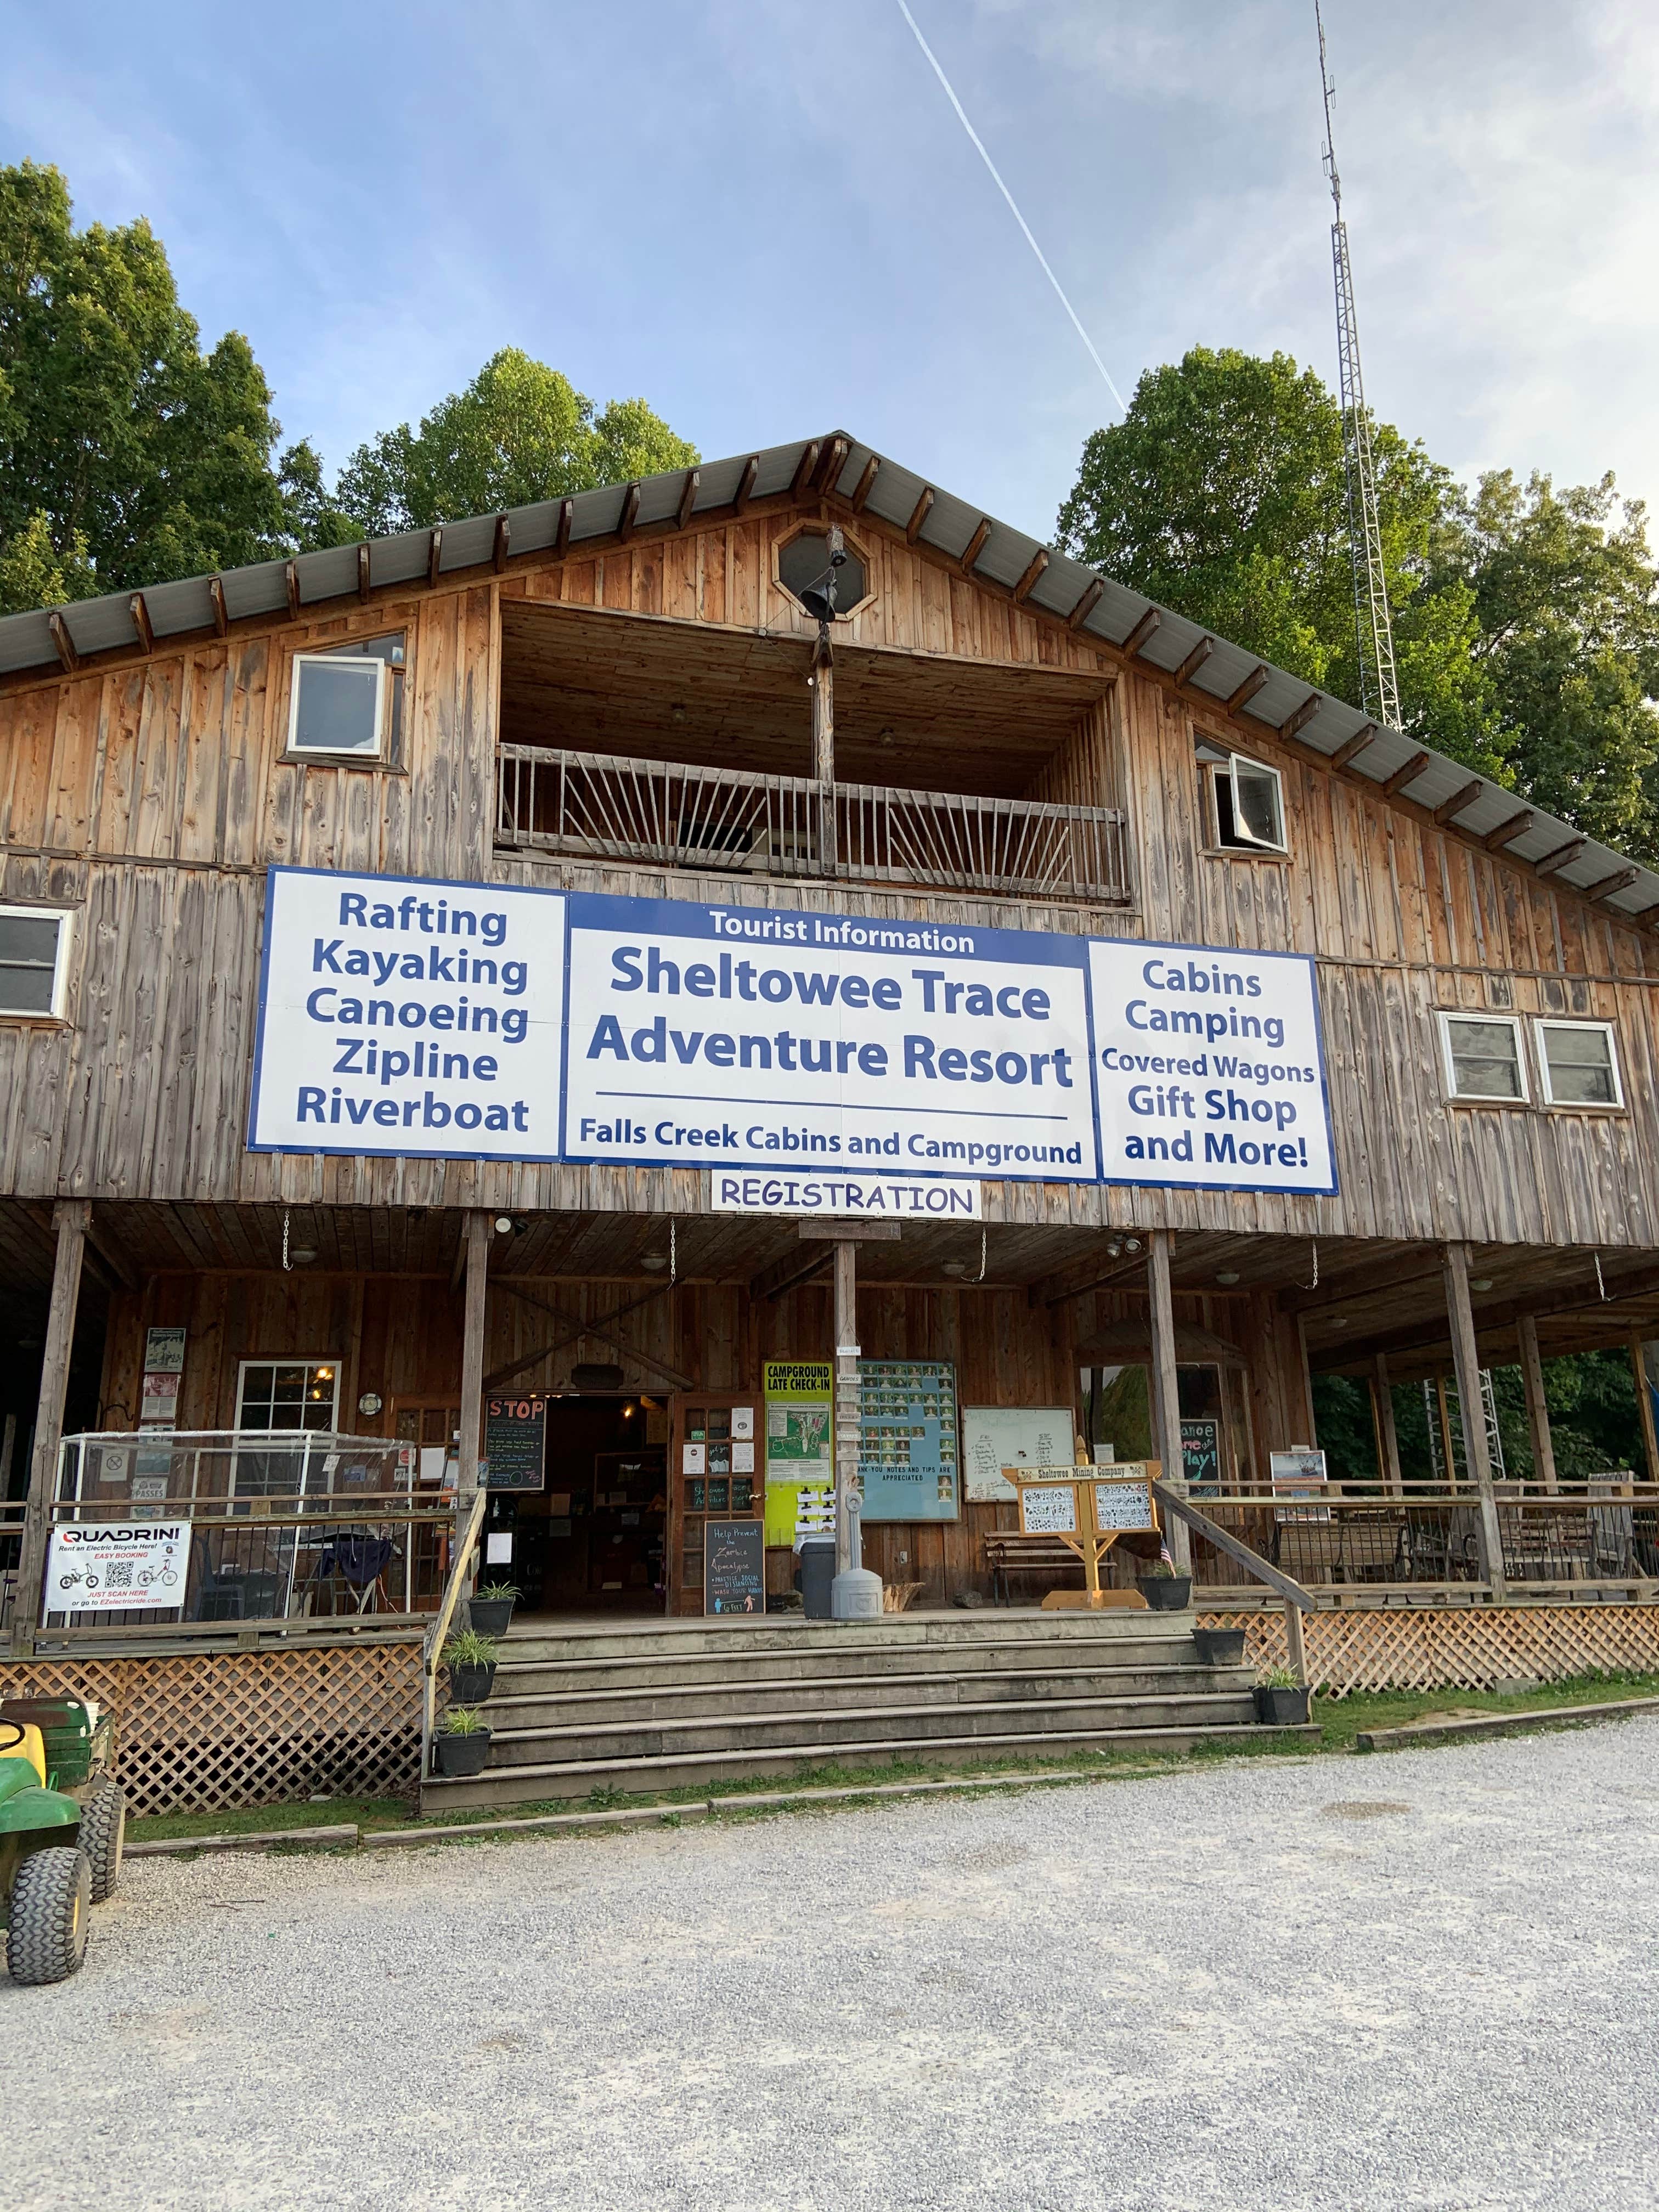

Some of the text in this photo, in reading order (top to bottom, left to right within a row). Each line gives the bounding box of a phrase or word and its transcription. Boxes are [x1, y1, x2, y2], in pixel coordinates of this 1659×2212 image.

[339, 893, 507, 946] Rafting
[709, 911, 974, 953] Tourist Information
[312, 939, 528, 996] Kayaking
[611, 946, 1050, 1020] Sheltowee Trace
[1143, 960, 1261, 997] Cabins
[306, 988, 528, 1043] Canoeing
[1125, 1000, 1284, 1048] Camping
[333, 1038, 498, 1085] Zipline
[586, 1014, 1073, 1088] Adventure Resort
[1101, 1047, 1315, 1086] Covered Wagons
[296, 1086, 529, 1132] Riverboat
[1128, 1085, 1297, 1131] Gift Shop
[580, 1118, 1082, 1166] Falls Creek Cabins and Campground
[1125, 1130, 1308, 1168] and More!
[721, 1178, 973, 1213] REGISTRATION
[768, 1365, 829, 1378] CAMPGROUND
[768, 1379, 830, 1390] LATE CHECK-IN
[490, 1400, 544, 1420] STOP
[1182, 1426, 1214, 1437] anoe
[1182, 1440, 1201, 1450] me
[1038, 1466, 1125, 1479] Sheltowee Mining Company
[136, 1489, 163, 1498] PASSES
[63, 1528, 180, 1543] QUADRINI
[714, 1527, 758, 1539] Help Prevent
[712, 1558, 750, 1575] Apocalypse
